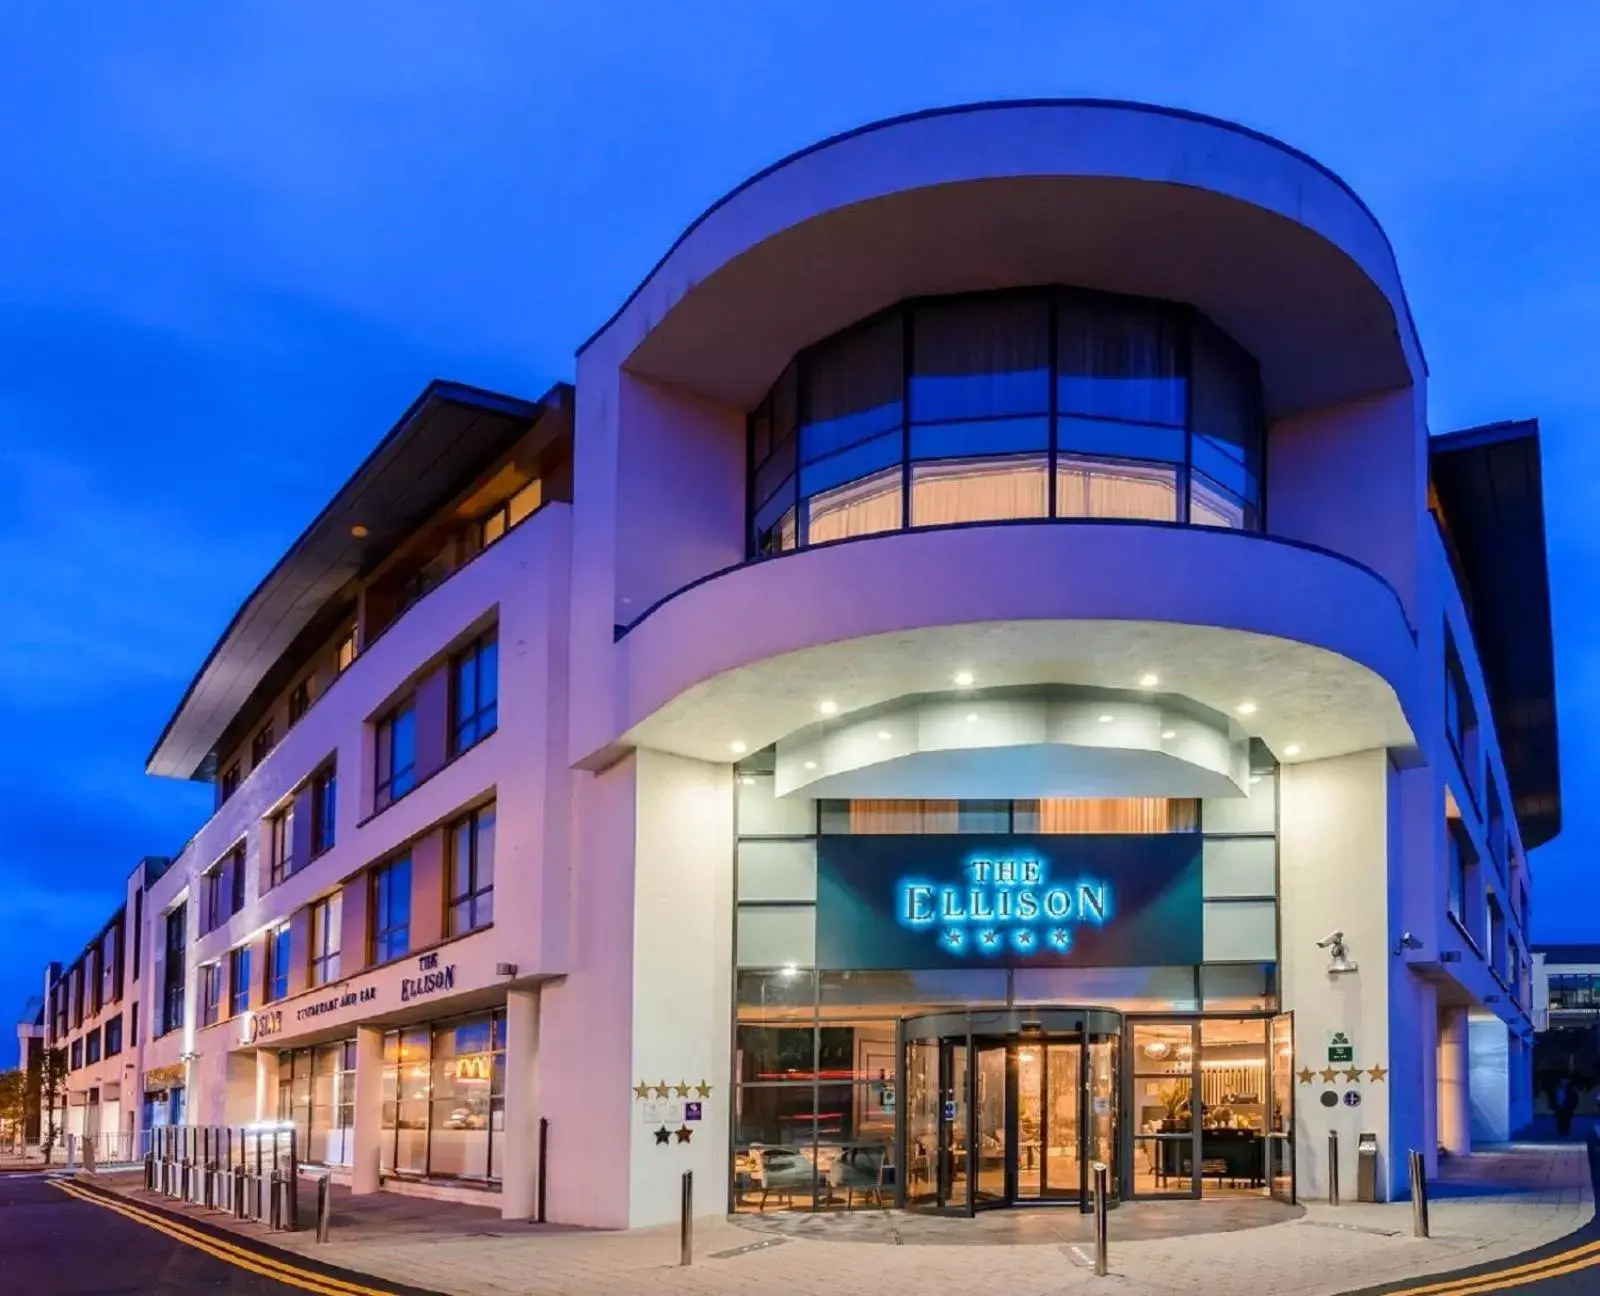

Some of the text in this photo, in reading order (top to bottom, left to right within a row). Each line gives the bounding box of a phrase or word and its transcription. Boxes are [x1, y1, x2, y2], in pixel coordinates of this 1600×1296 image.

[971, 860, 1041, 883] THE
[905, 881, 1107, 921] ELLISON
[401, 964, 456, 1002] ELLISON
